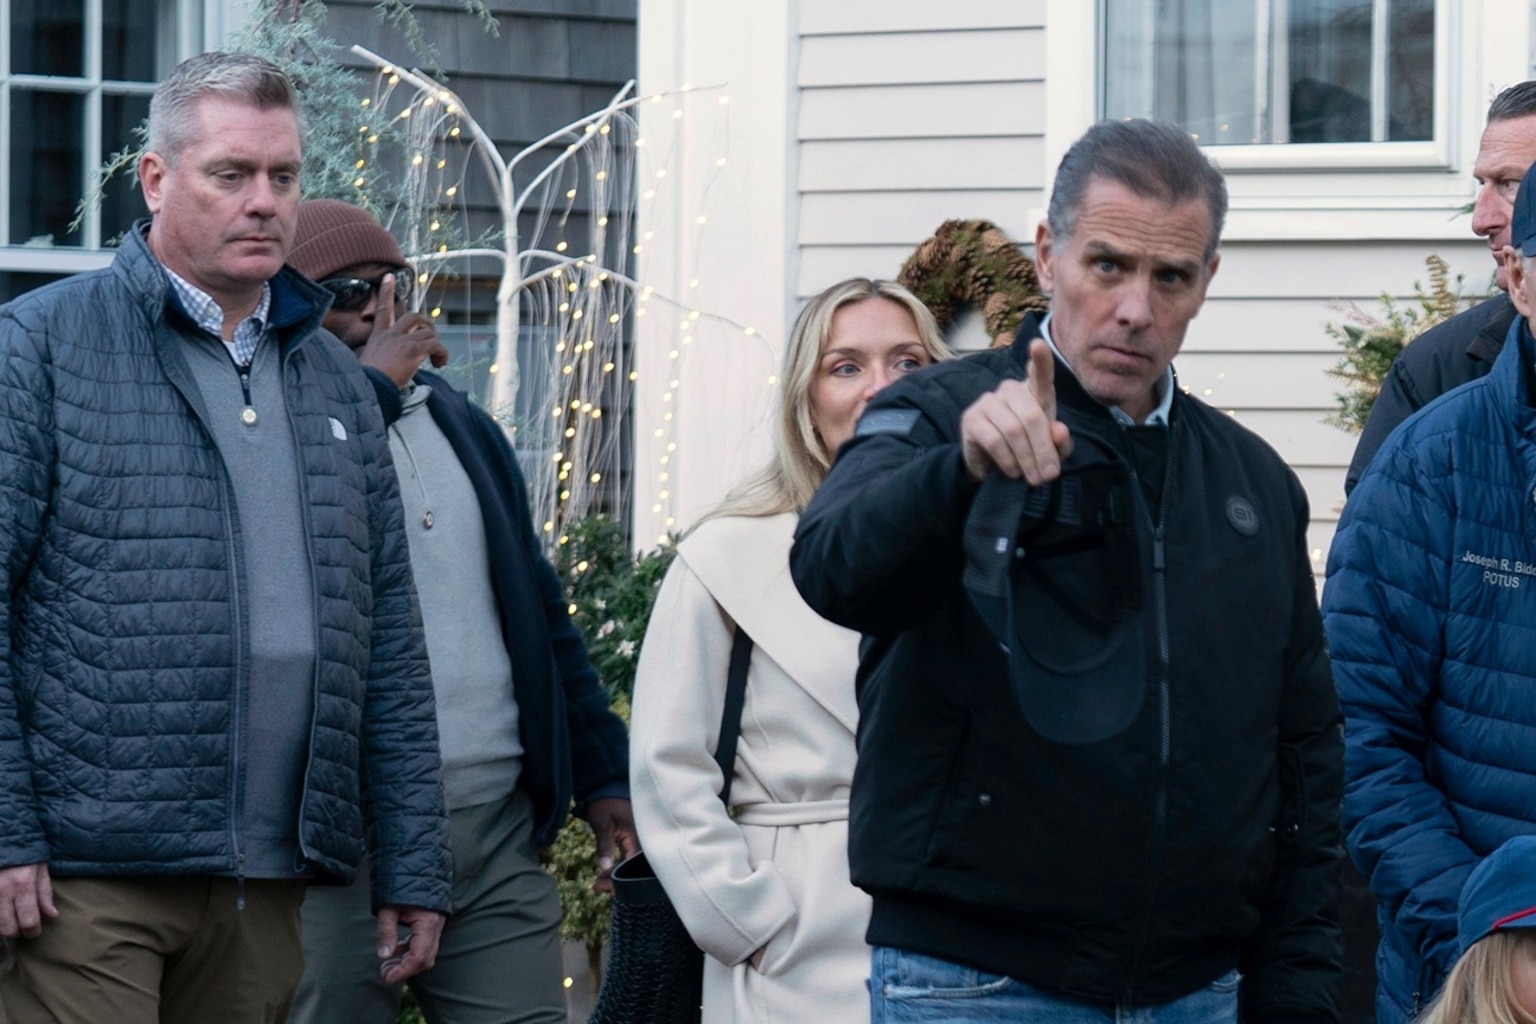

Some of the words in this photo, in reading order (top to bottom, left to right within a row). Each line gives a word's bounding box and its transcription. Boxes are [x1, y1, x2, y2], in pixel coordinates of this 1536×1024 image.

[1462, 550, 1498, 569] Joseph
[1500, 558, 1512, 571] R.
[1483, 570, 1520, 588] POTUS
